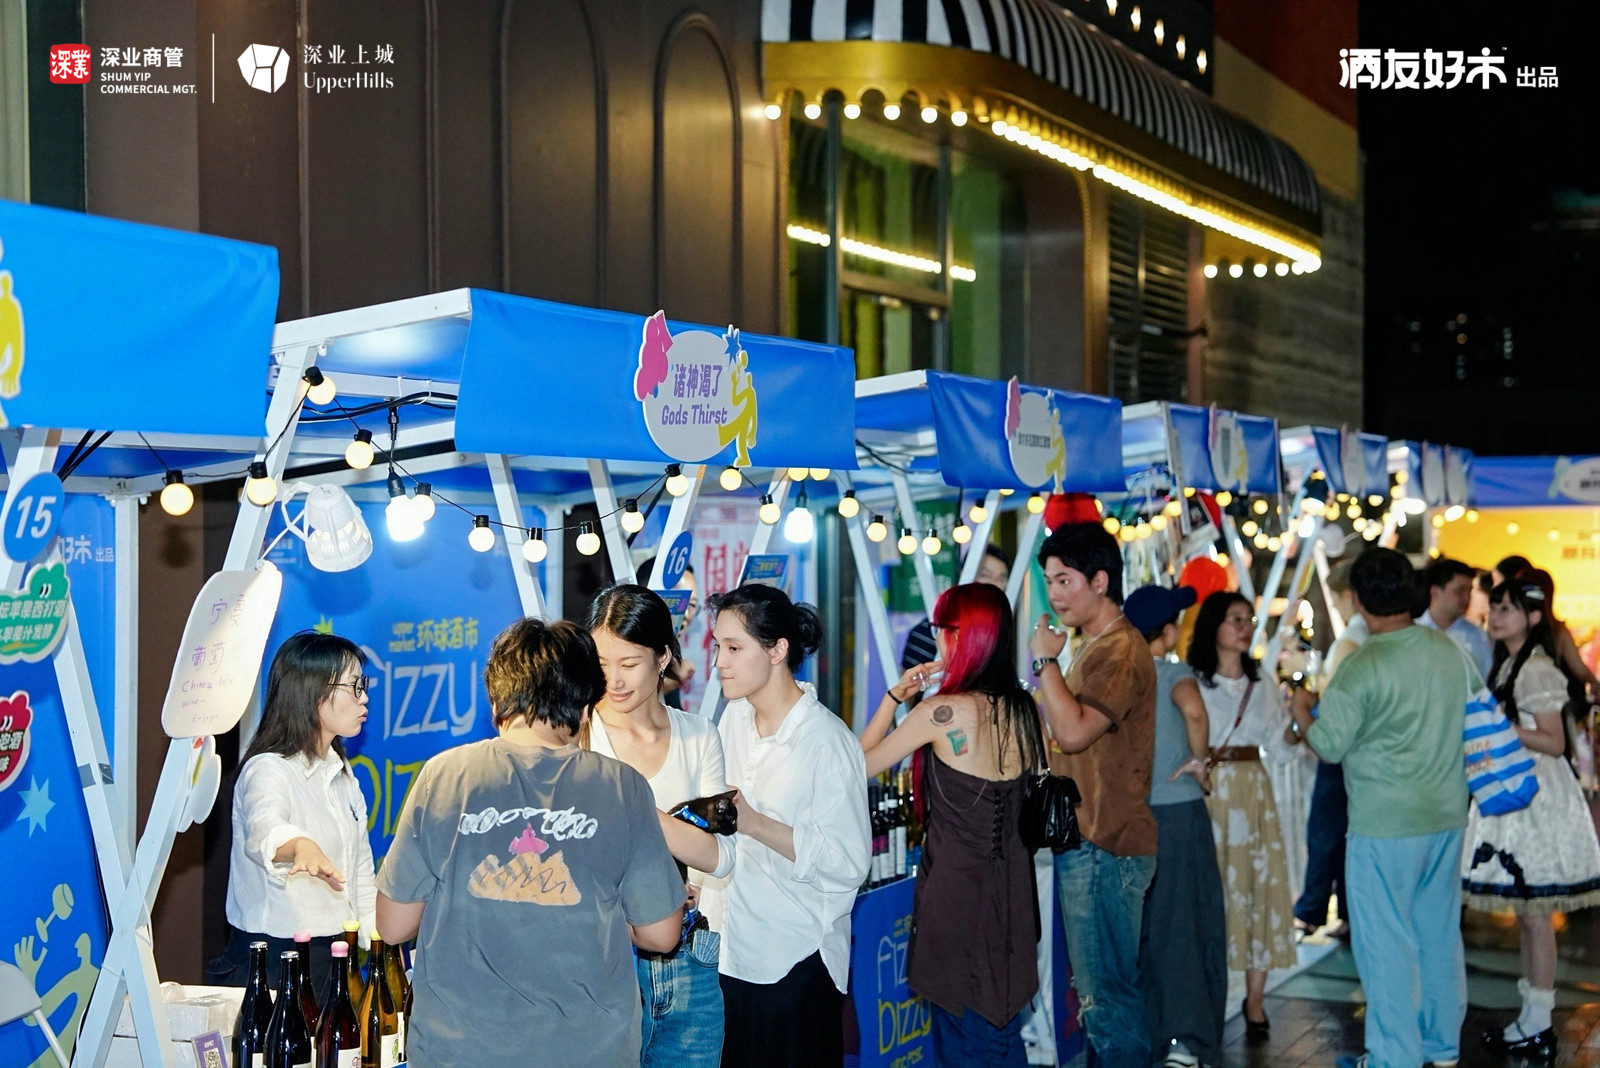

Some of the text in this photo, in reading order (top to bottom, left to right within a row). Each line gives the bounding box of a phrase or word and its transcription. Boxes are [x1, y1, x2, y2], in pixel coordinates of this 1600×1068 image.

[661, 405, 728, 425] Gods Thirst
[15, 496, 56, 539] 15
[667, 547, 686, 575] 16
